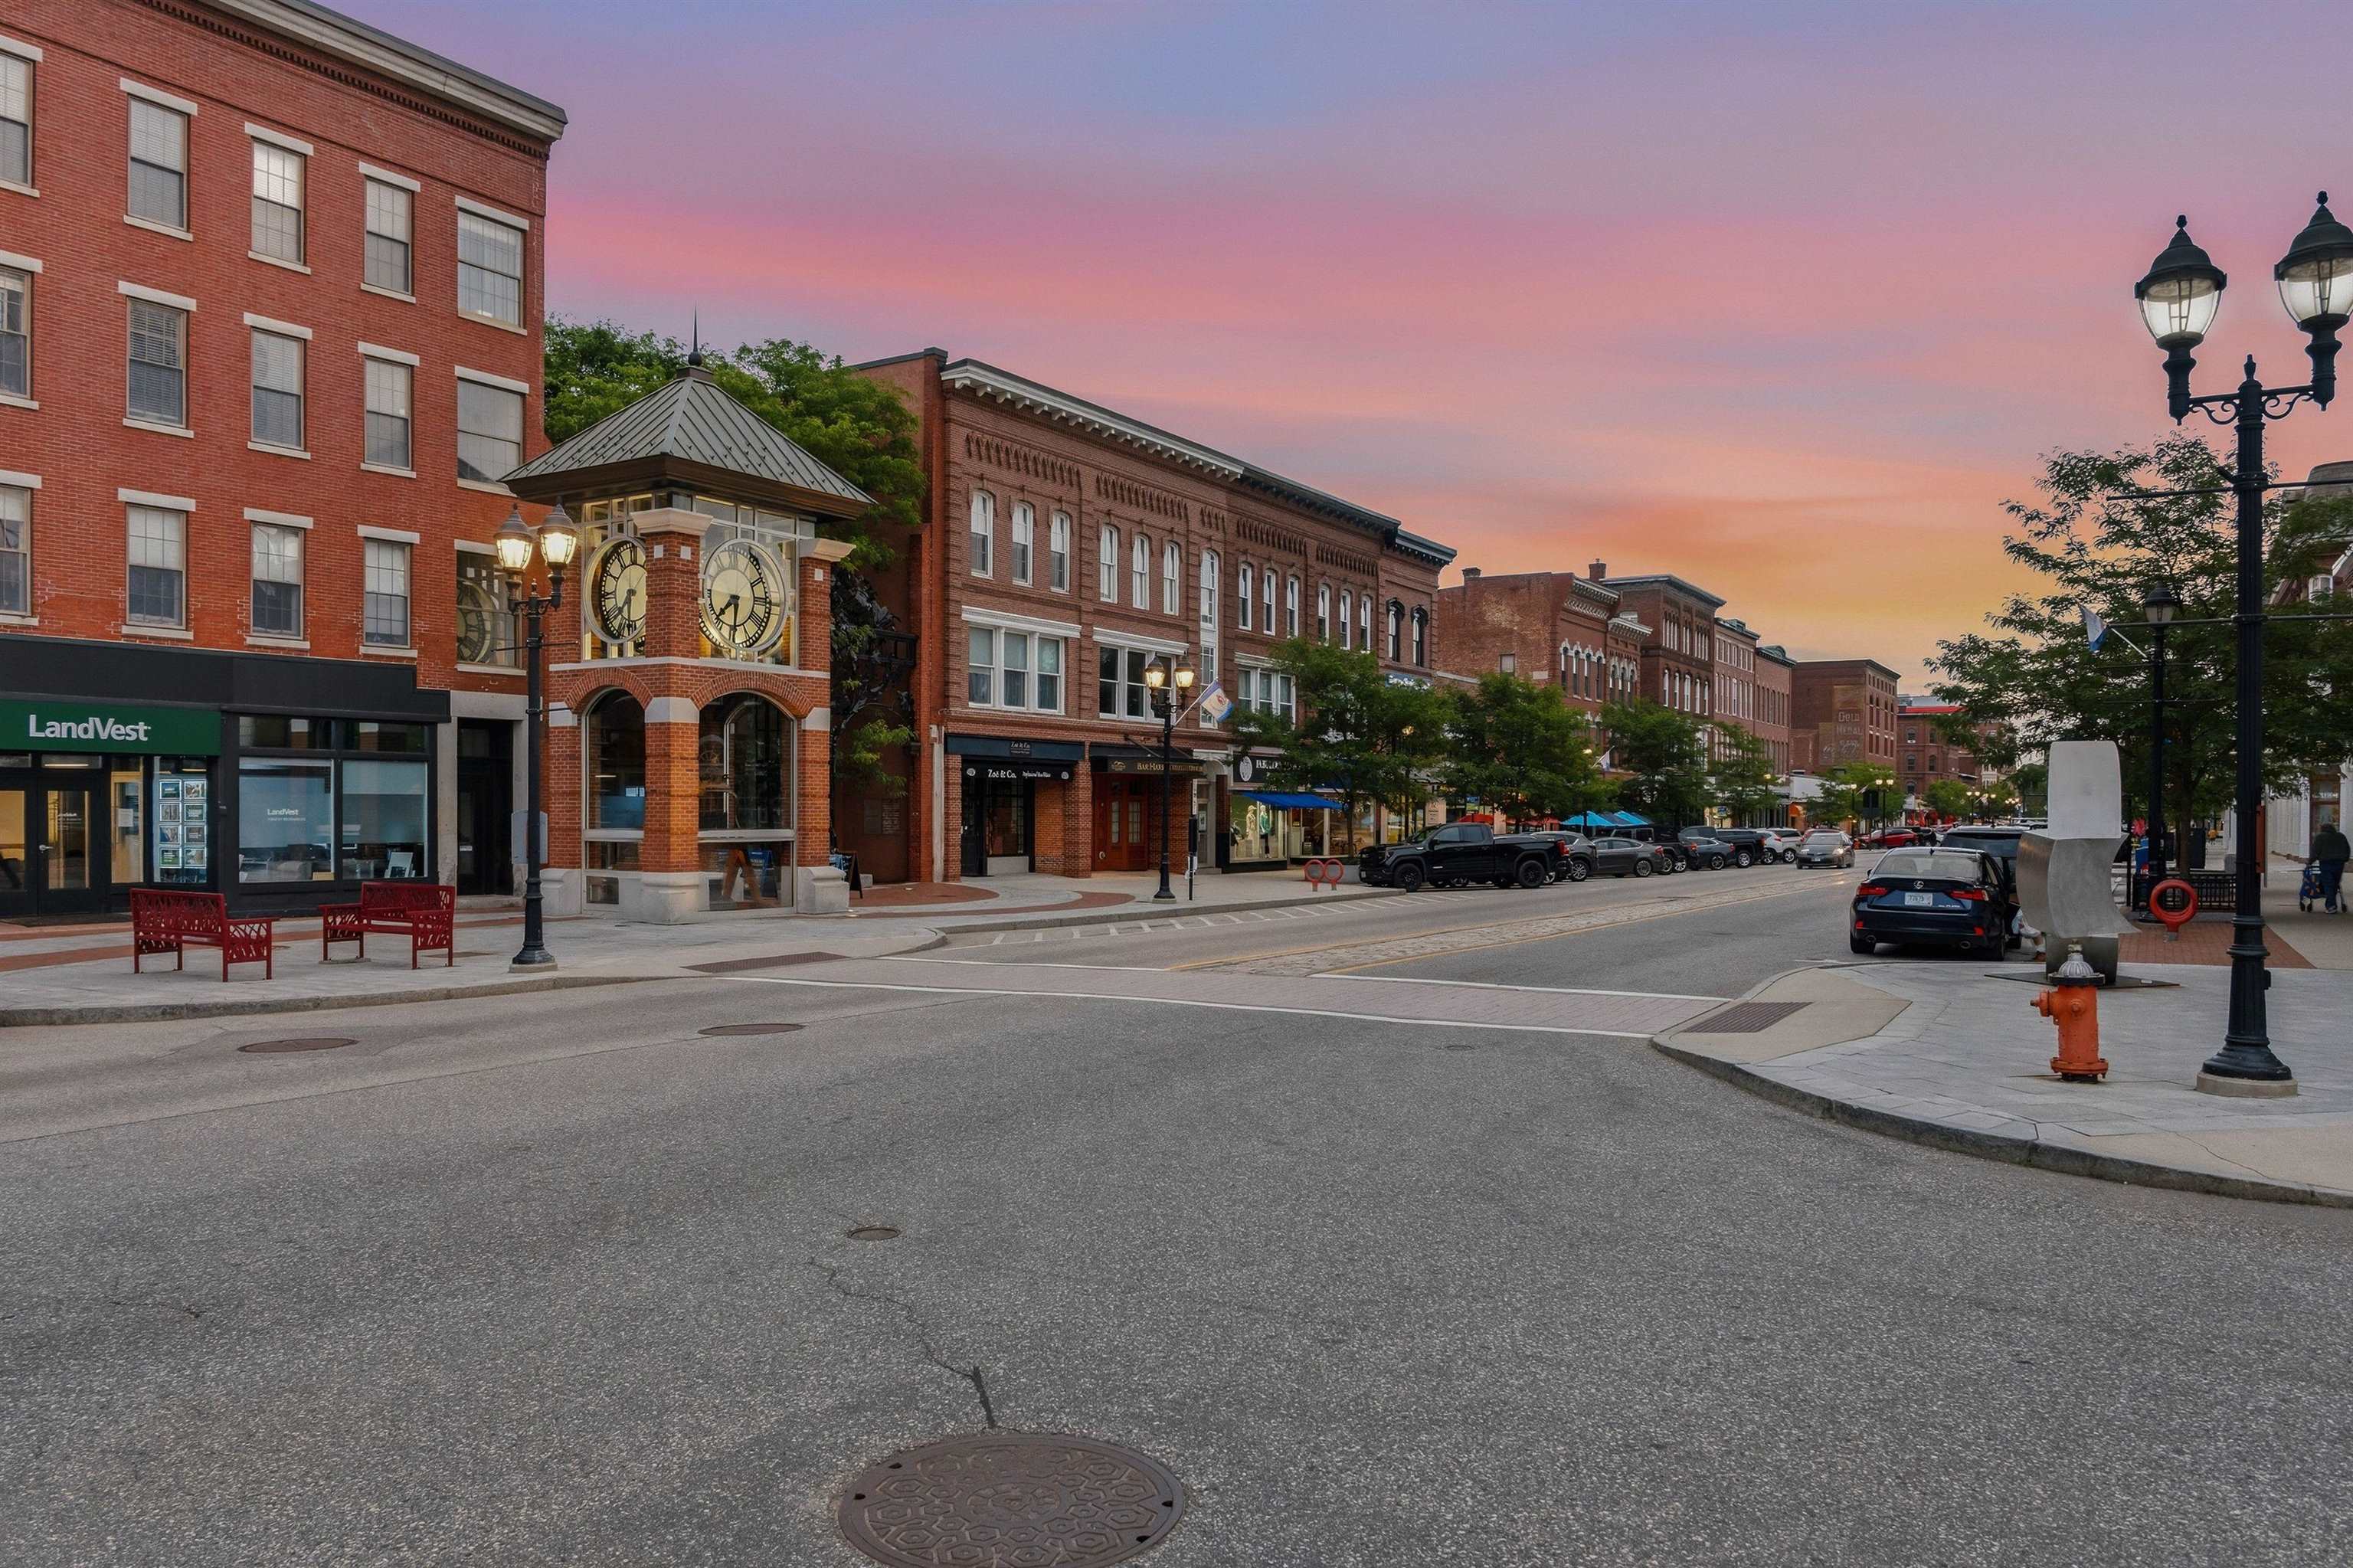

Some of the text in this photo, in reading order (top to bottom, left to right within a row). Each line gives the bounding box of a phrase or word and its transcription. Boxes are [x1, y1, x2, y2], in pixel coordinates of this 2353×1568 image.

[29, 715, 148, 741] LandVest
[1000, 770, 1006, 778] &
[1006, 770, 1016, 778] Co.
